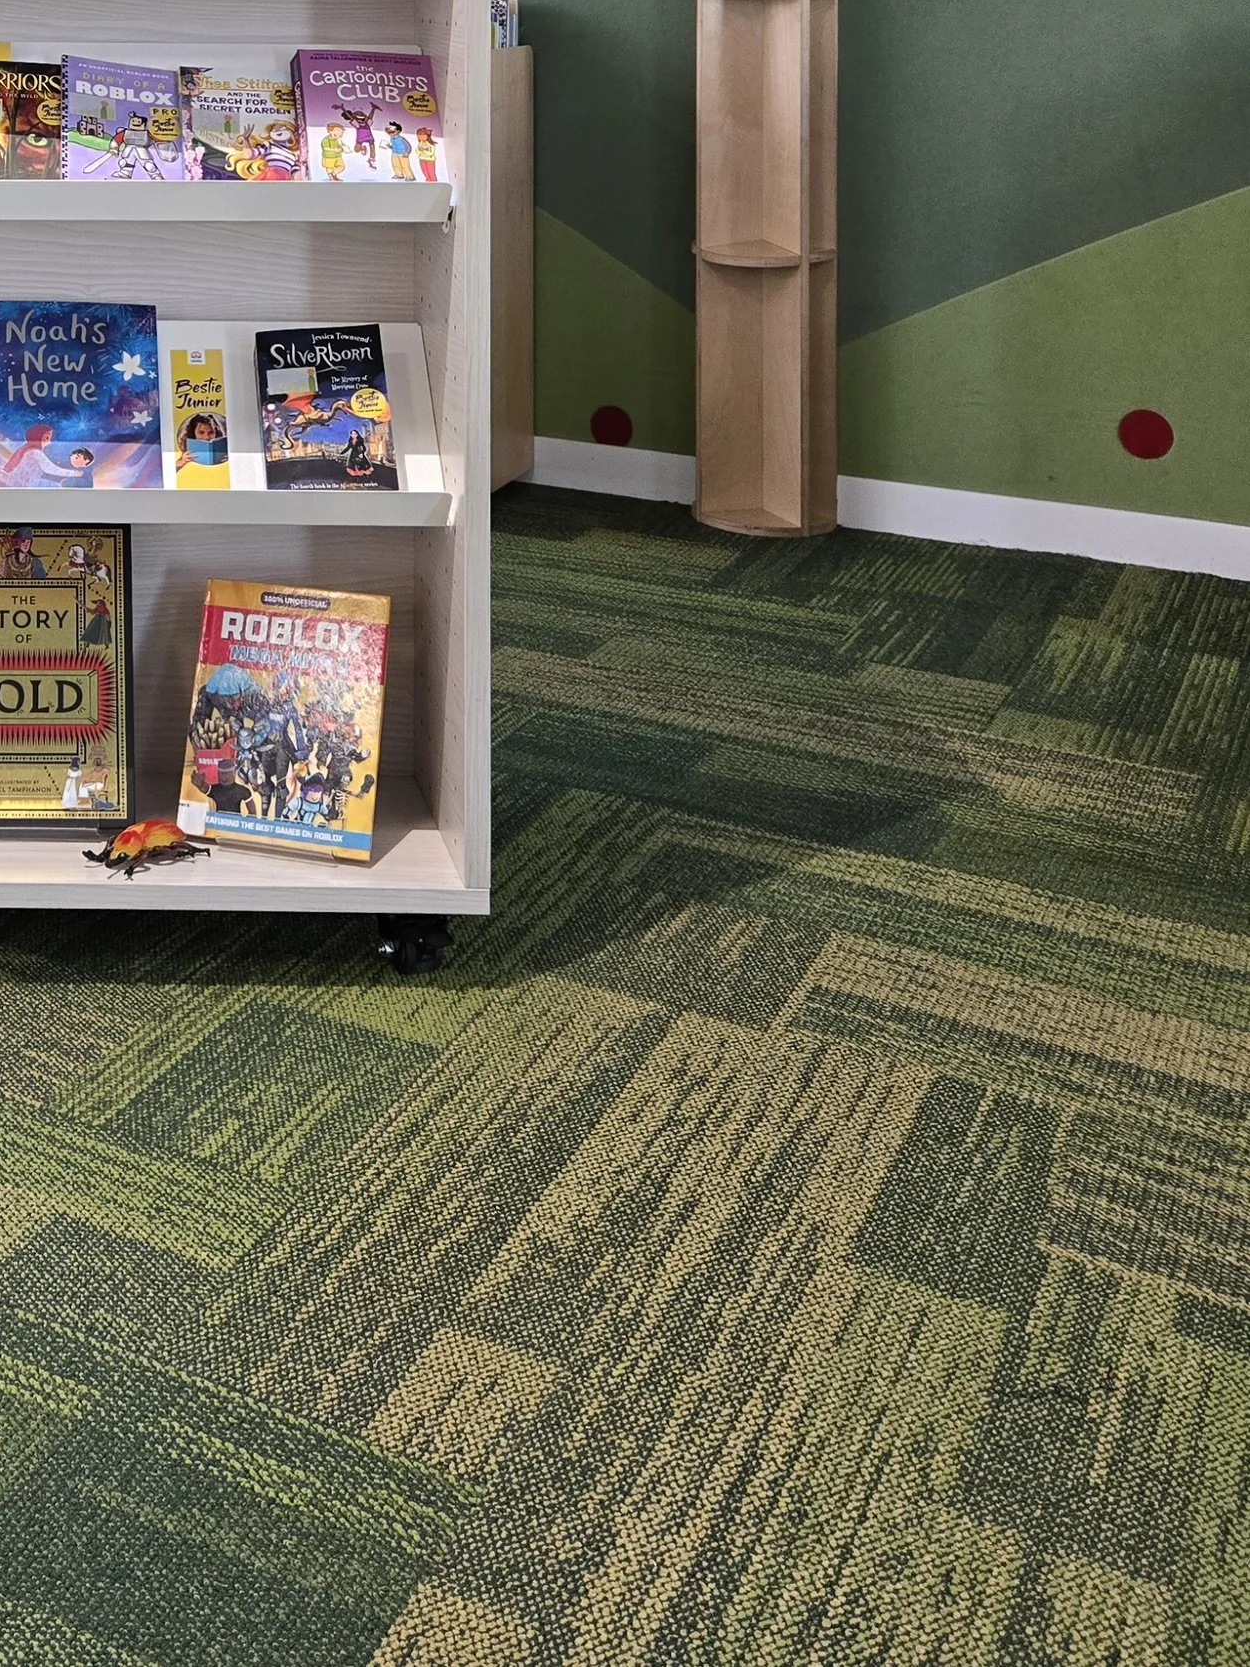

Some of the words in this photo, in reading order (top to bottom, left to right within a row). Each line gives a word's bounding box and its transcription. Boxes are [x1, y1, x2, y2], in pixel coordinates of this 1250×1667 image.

[88, 64, 125, 74] UNOFFICIAL
[83, 72, 125, 85] DIARY
[133, 80, 149, 88] OF
[75, 79, 174, 107] ROBLOX
[196, 95, 243, 105] SEARCH
[245, 98, 268, 106] FOR
[336, 83, 401, 104] CLUB
[199, 103, 242, 113] SECRET
[245, 106, 291, 115] GARDEN
[5, 309, 107, 345] Noah's
[312, 333, 335, 344] Jessica
[335, 332, 370, 344] Townsend
[23, 344, 86, 373] New
[175, 377, 223, 395] Bestie
[331, 376, 341, 384] The
[341, 376, 361, 384] Mystery
[7, 372, 98, 407] Home
[175, 390, 221, 410] Junior
[11, 595, 36, 606] THE
[284, 597, 328, 609] UNOFFICIAL
[15, 634, 33, 644] OF
[221, 610, 364, 654] ROBLOX
[240, 821, 255, 830] THE
[255, 823, 274, 832] BEST
[275, 825, 301, 837] GAMES
[301, 829, 313, 839] ON
[313, 831, 344, 843] ROBLOX
